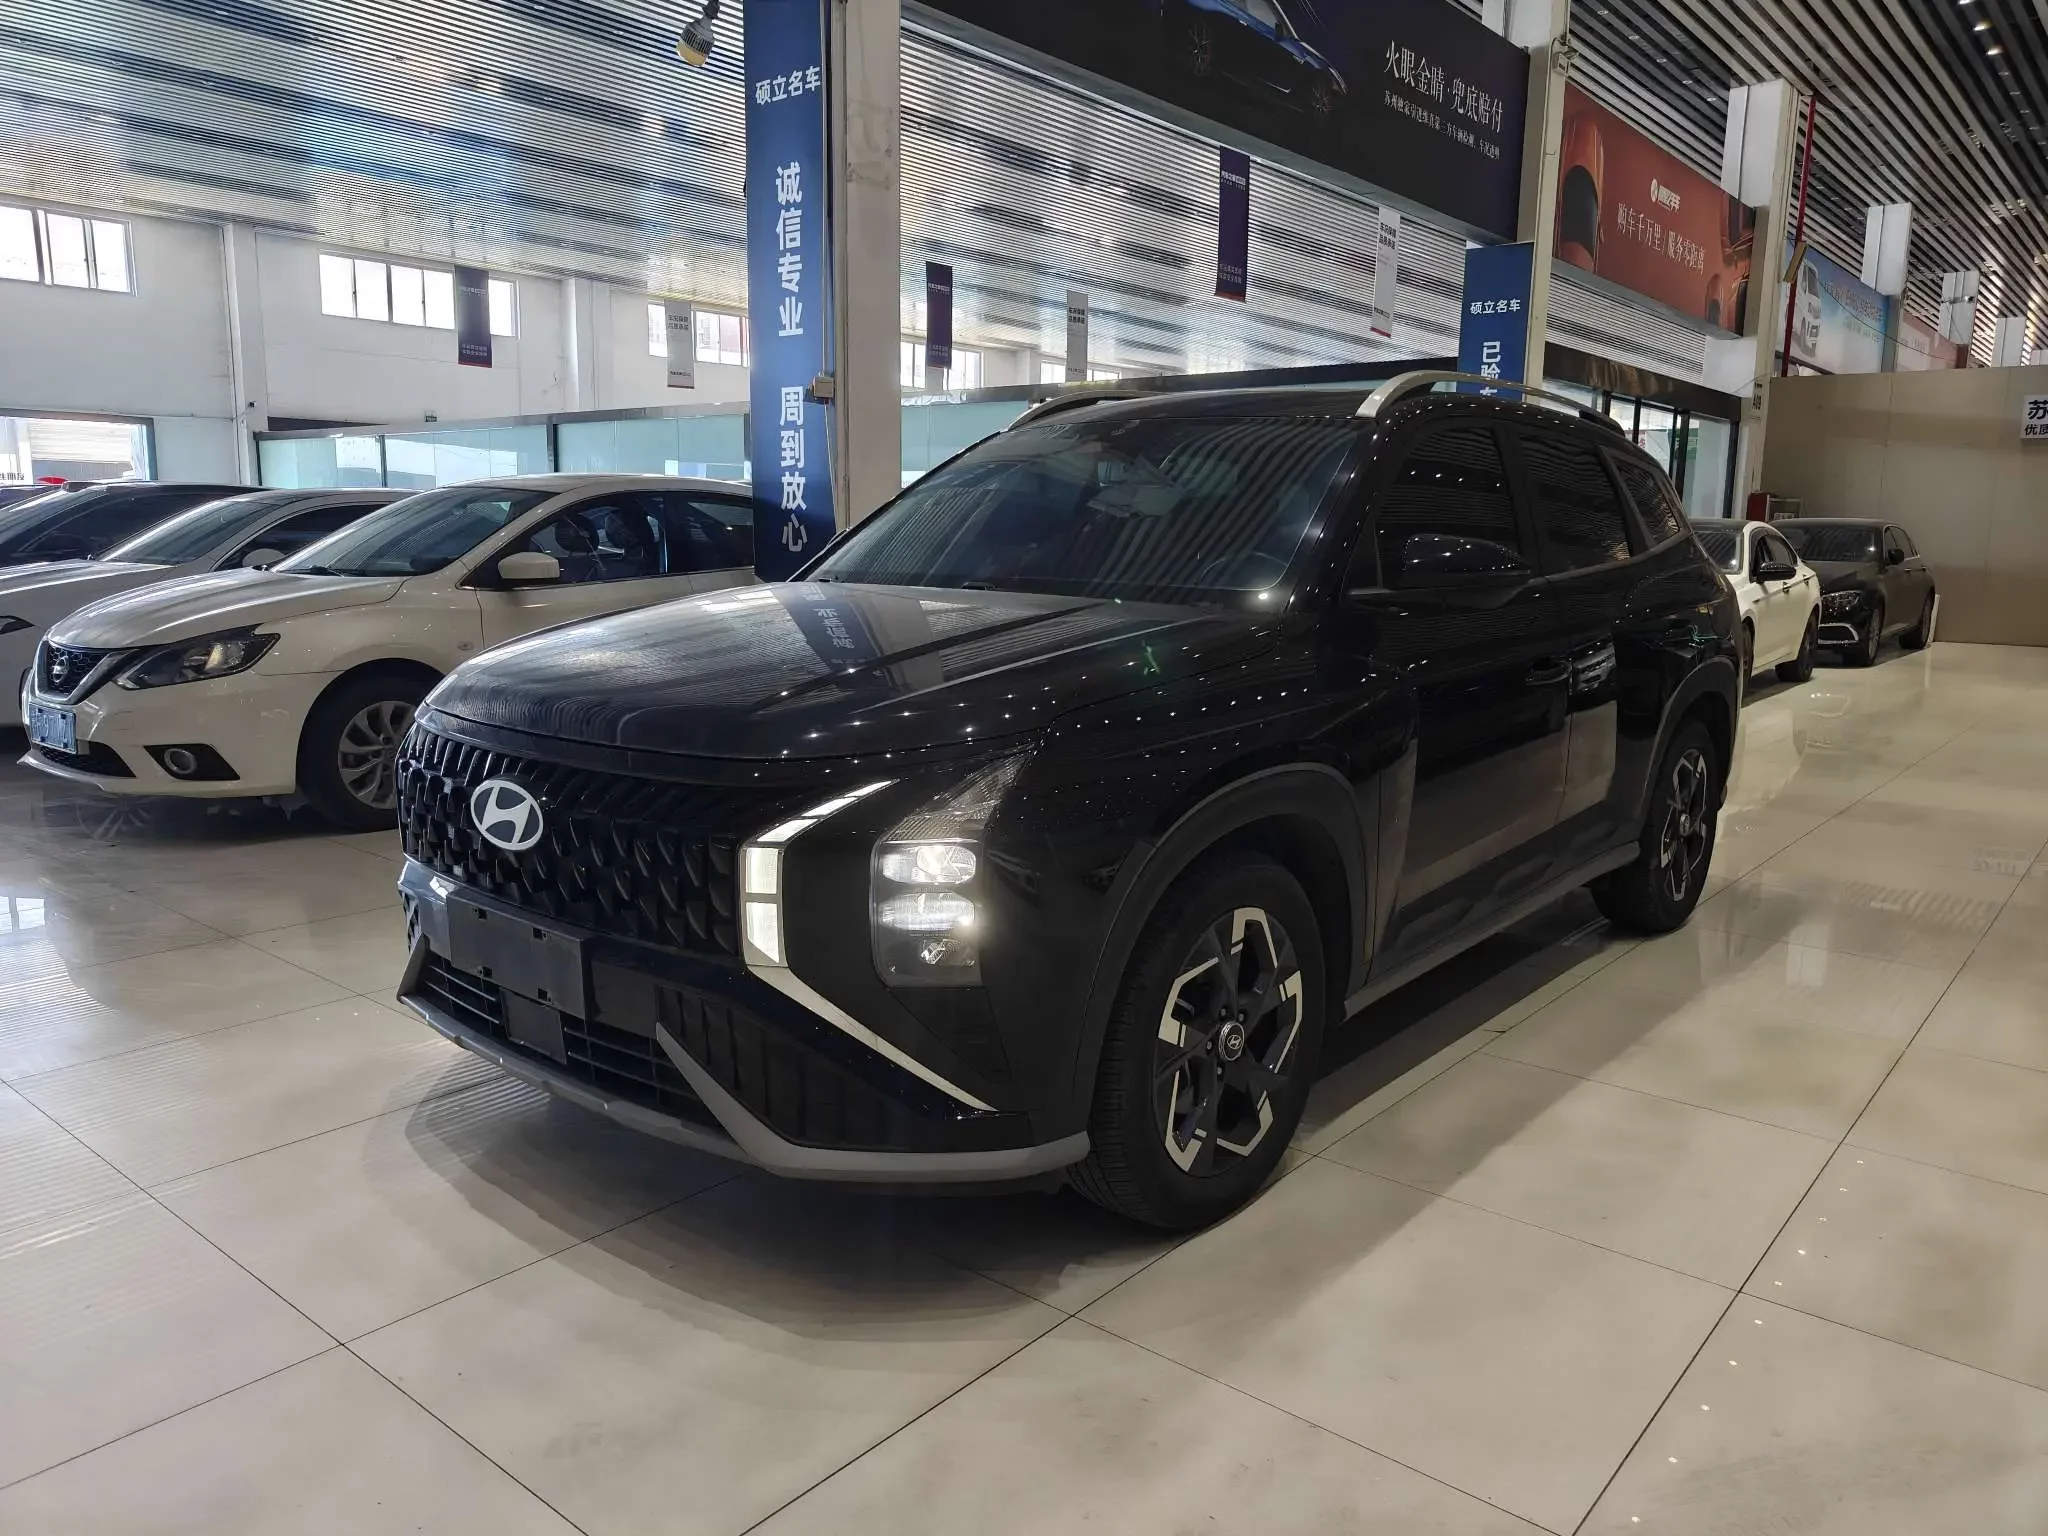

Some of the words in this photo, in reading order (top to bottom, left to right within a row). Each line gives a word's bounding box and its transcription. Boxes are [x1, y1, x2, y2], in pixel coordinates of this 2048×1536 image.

[755, 65, 821, 105] 硕立名车
[776, 160, 804, 337] 诚信专业
[1470, 299, 1521, 314] 硕立名车
[779, 386, 807, 552] 周到放心
